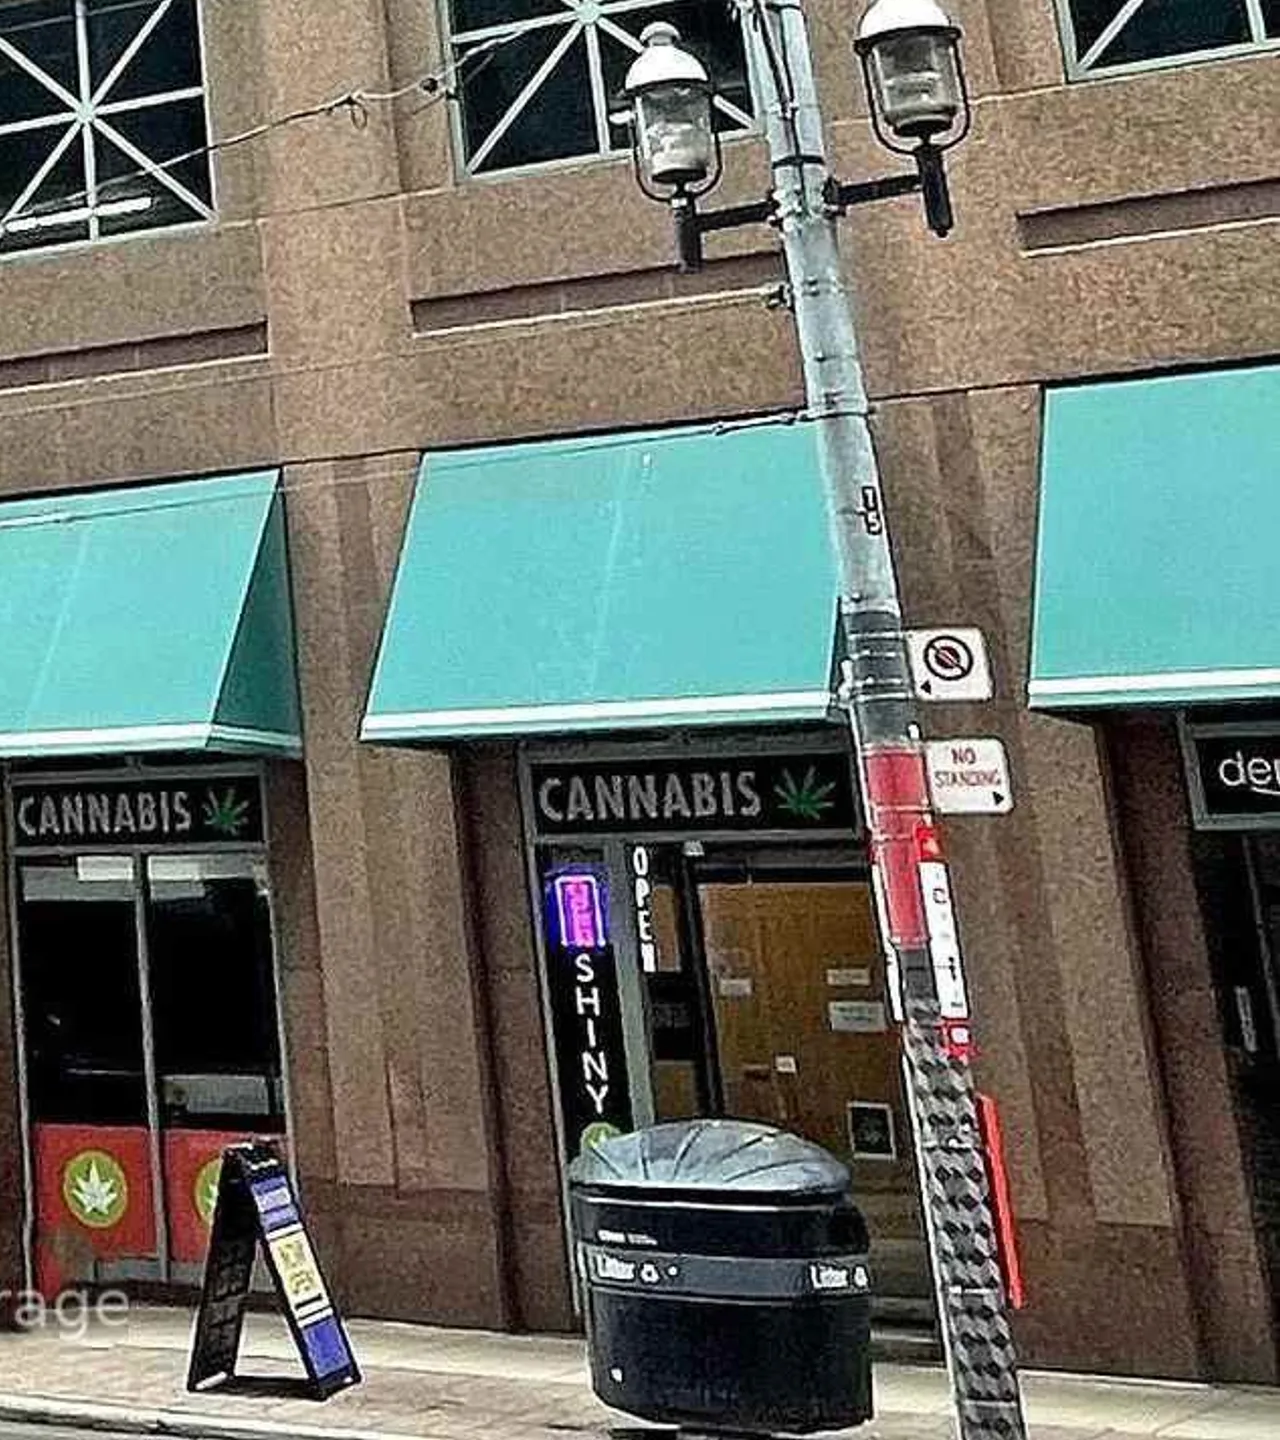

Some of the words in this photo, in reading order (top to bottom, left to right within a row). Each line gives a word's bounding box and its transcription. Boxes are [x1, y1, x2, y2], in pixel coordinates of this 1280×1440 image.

[951, 747, 976, 764] NO
[17, 791, 191, 836] CANNABIS
[539, 771, 762, 821] CANNABIS
[575, 953, 609, 1114] SHINY
